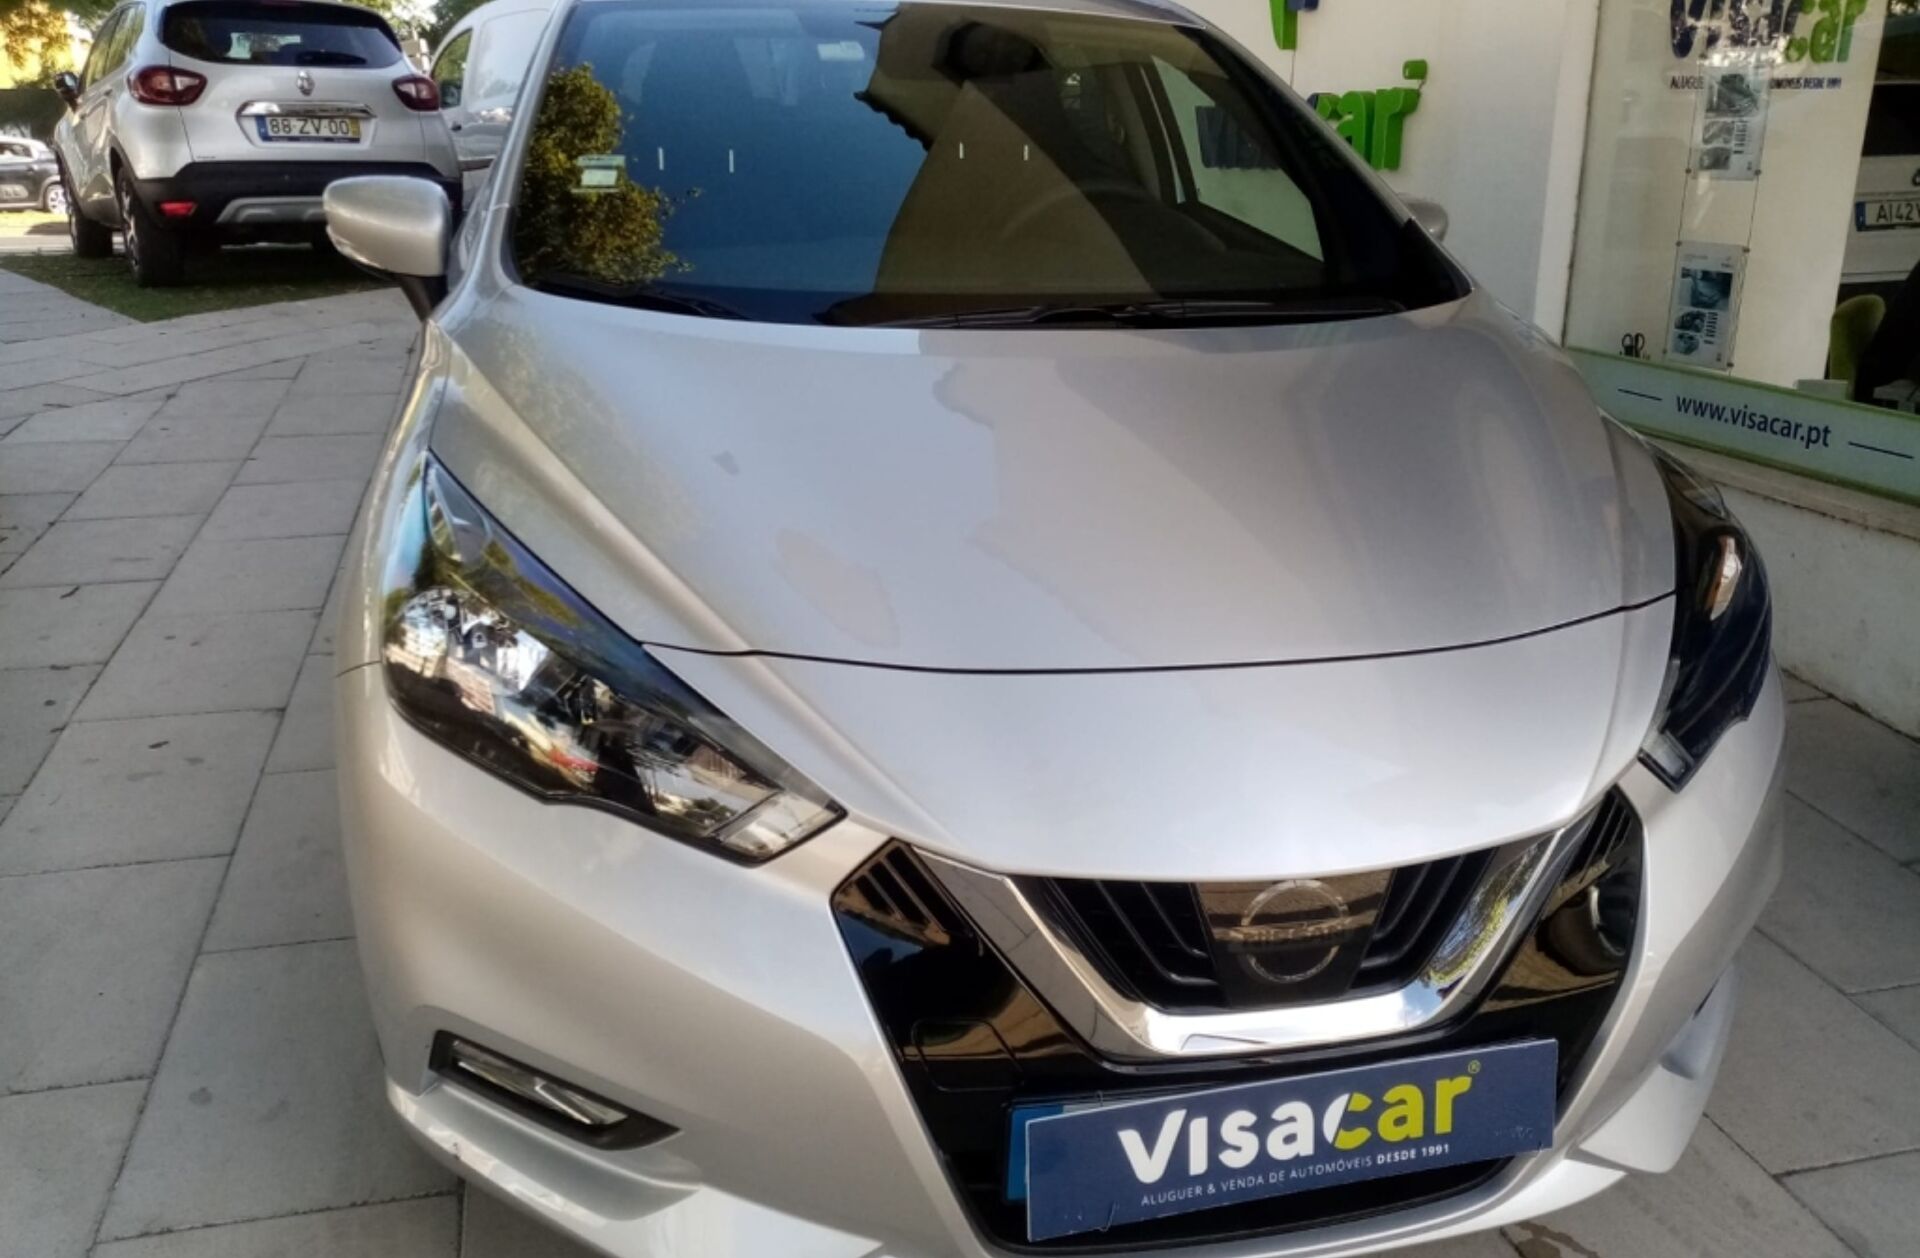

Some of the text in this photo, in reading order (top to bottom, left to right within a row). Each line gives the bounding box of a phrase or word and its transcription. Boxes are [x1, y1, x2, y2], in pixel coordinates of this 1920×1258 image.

[1676, 395, 1832, 449] www.visacar.pt
[1141, 1144, 1449, 1206] ALUGUER & VENDA DE AUTOMÓVEIS DESDE 1991
